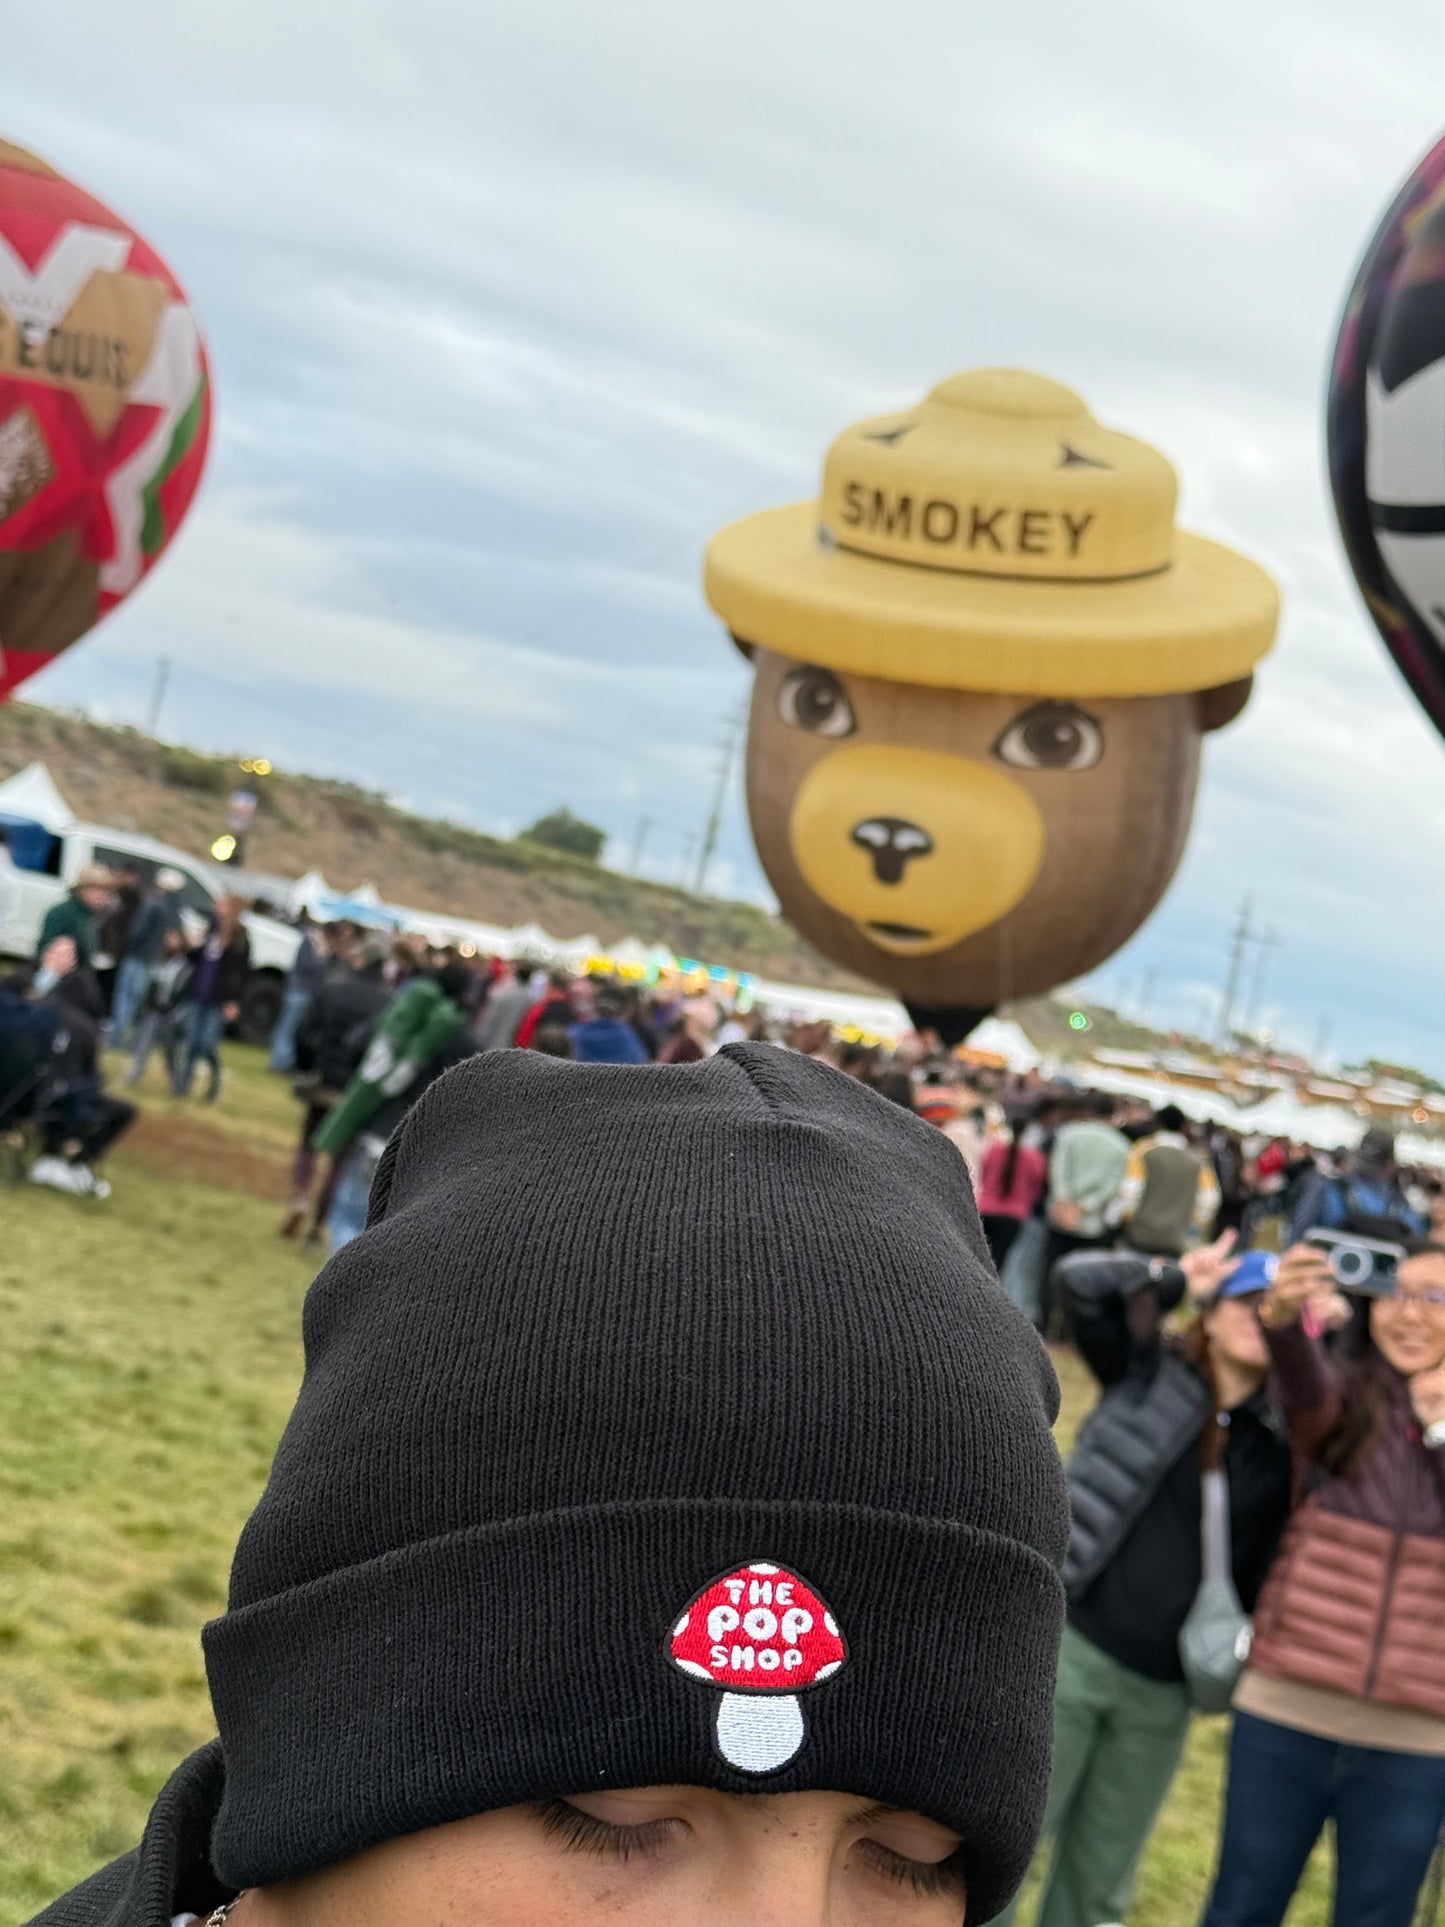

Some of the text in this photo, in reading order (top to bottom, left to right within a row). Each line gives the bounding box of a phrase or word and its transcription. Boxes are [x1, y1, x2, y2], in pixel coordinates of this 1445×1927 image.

[842, 480, 1095, 556] SMOKEY
[724, 1579, 795, 1605] THE
[707, 1605, 814, 1644] POP
[710, 1645, 803, 1671] SHOP
